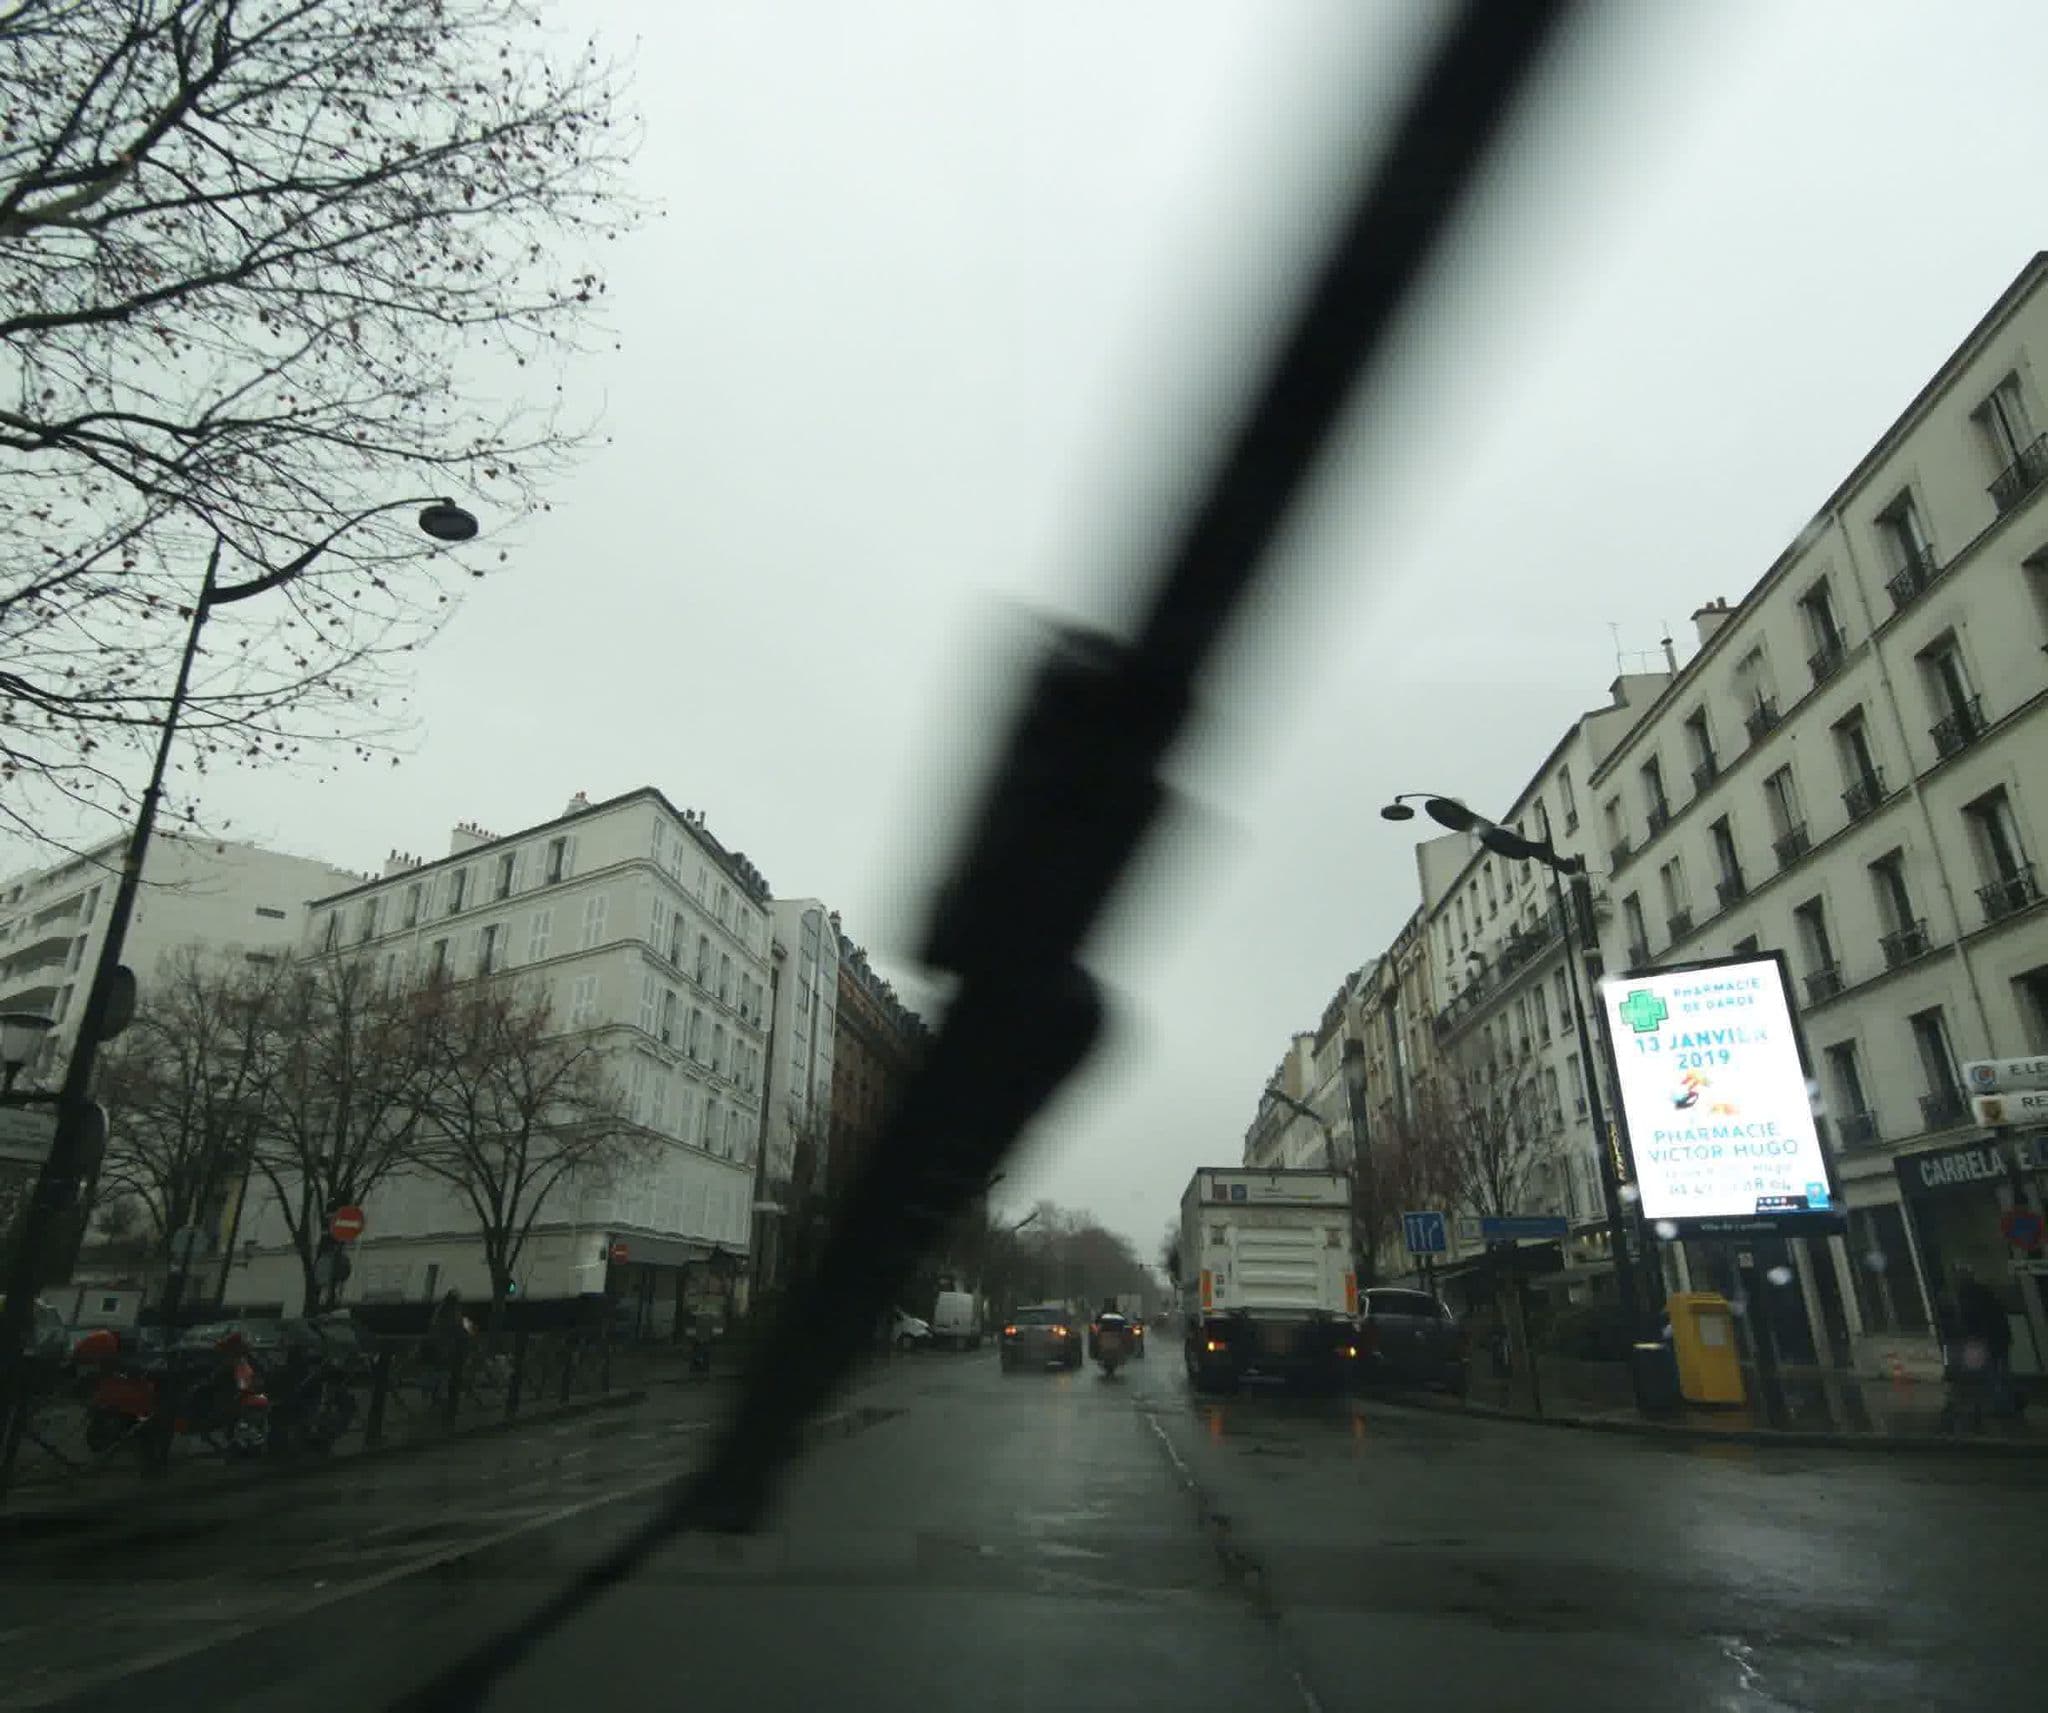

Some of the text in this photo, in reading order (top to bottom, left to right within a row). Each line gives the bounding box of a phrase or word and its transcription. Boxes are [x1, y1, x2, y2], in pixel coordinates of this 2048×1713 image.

[1674, 977, 1760, 997] PHARMACIE
[1636, 1036, 1660, 1053] 13
[1678, 1049, 1730, 1070] 2019
[1654, 1121, 1776, 1144] PHARMACIE
[1648, 1138, 1798, 1164] VICTOR HUGO
